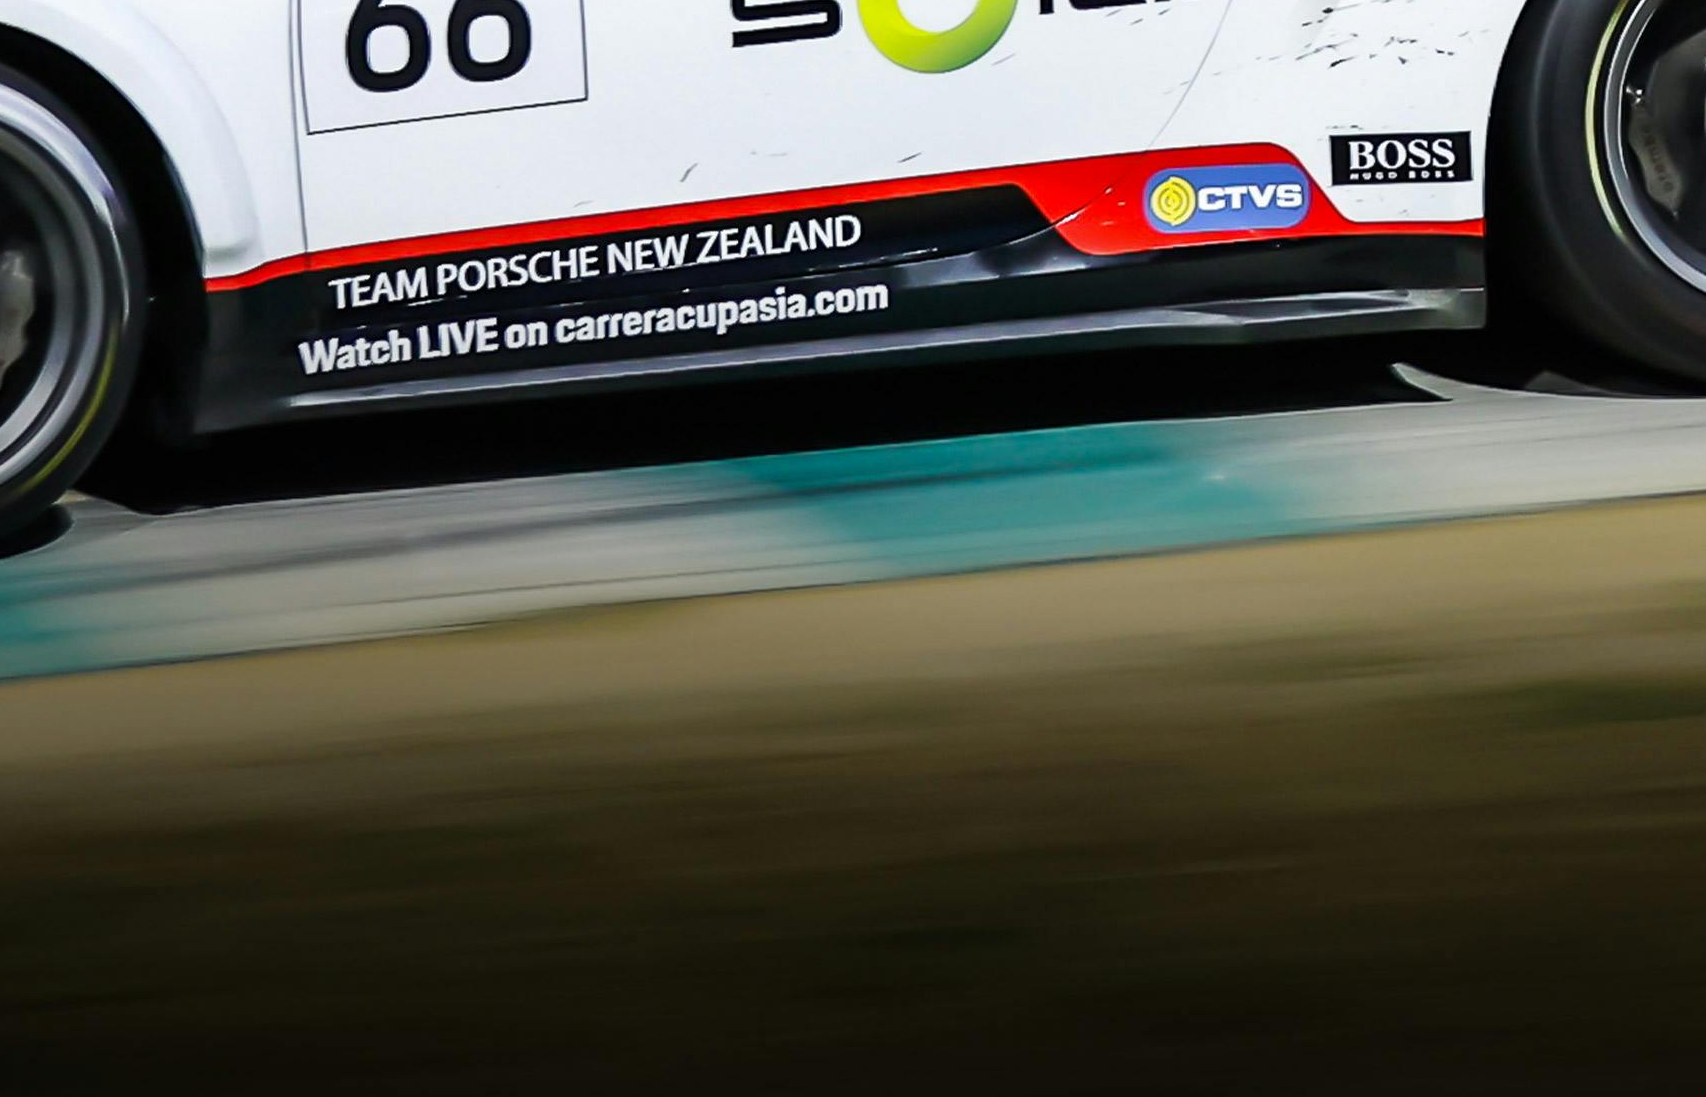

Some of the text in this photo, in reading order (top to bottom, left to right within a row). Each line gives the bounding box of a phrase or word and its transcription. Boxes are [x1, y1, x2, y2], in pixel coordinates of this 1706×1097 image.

[1348, 138, 1456, 170] BOSS
[1197, 184, 1303, 211] CTVS
[327, 215, 861, 309] TEAM PORSCHE NEW ZEALAND
[298, 284, 889, 375] Watch LIVE on carreracupasia.com
